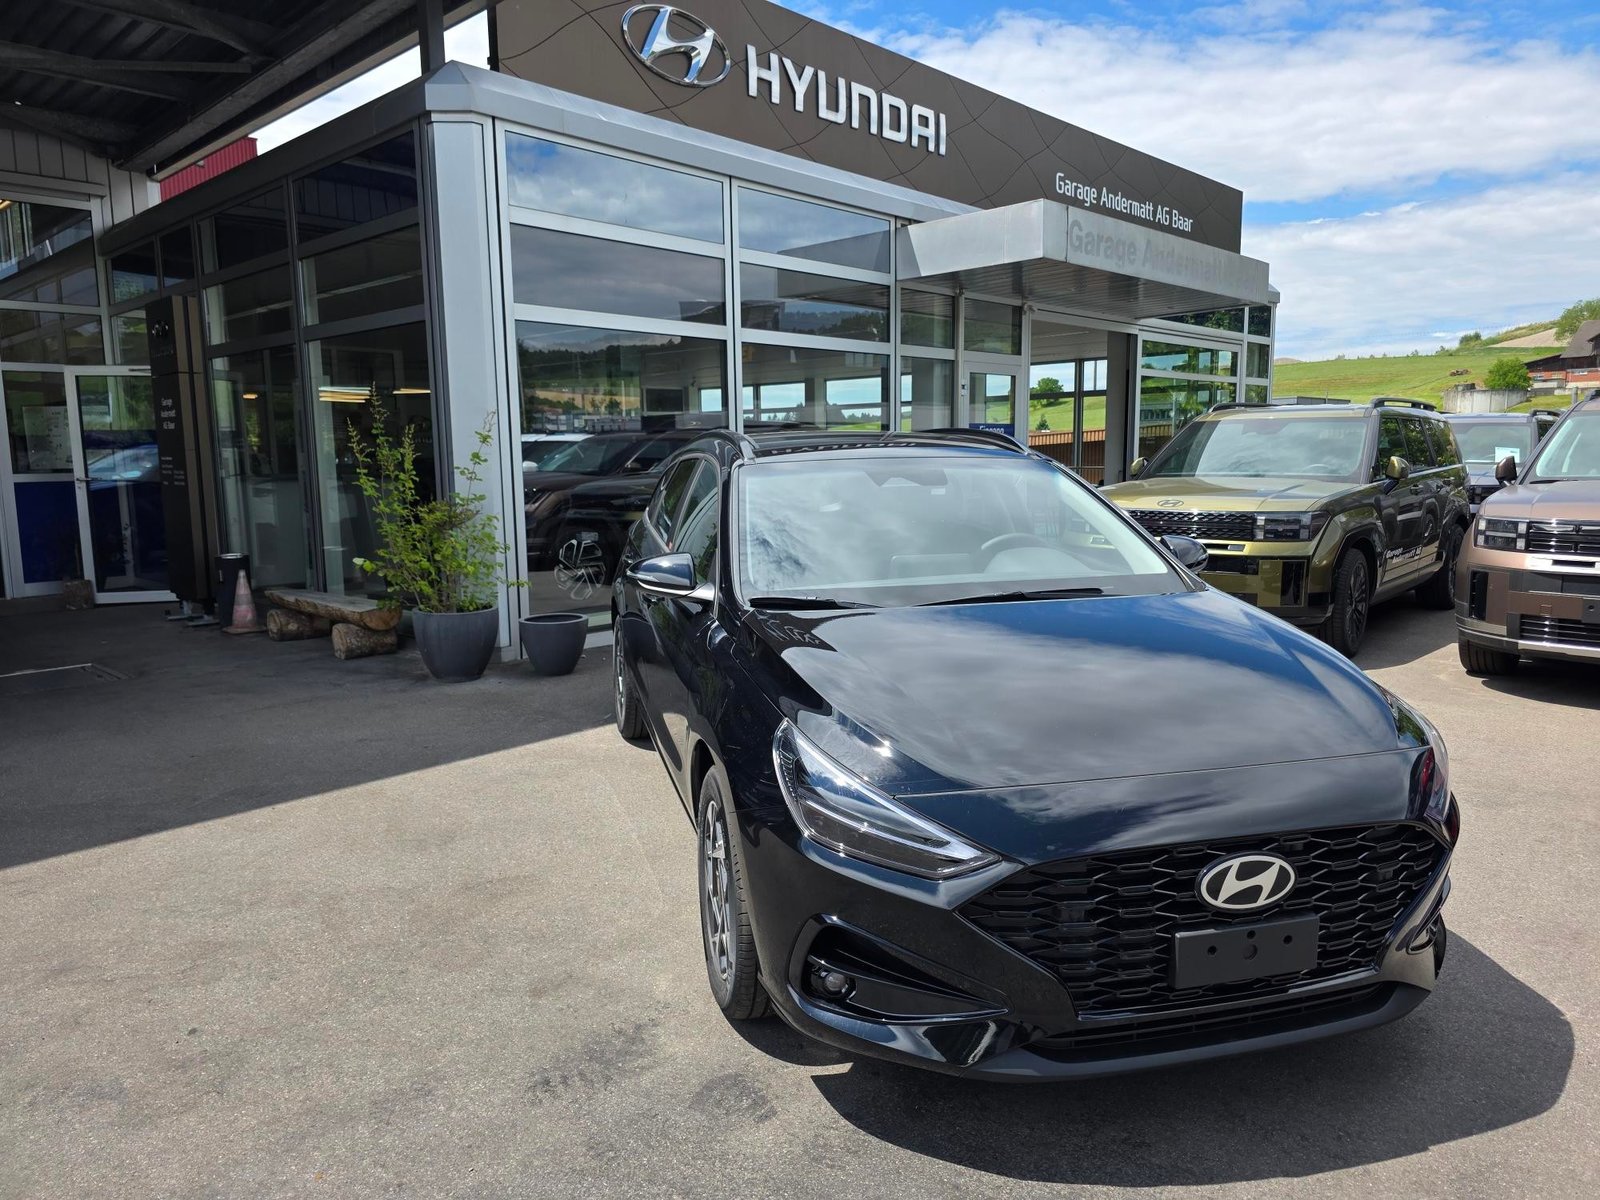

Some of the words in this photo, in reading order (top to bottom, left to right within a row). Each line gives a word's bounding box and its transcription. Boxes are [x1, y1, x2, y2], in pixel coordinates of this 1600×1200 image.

[746, 43, 947, 156] HYUNDAI
[1055, 172, 1098, 207] Garage
[1100, 186, 1154, 221] Andermatt
[1155, 204, 1170, 226] AG
[1172, 208, 1194, 233] Baar
[1069, 218, 1138, 270] Garage
